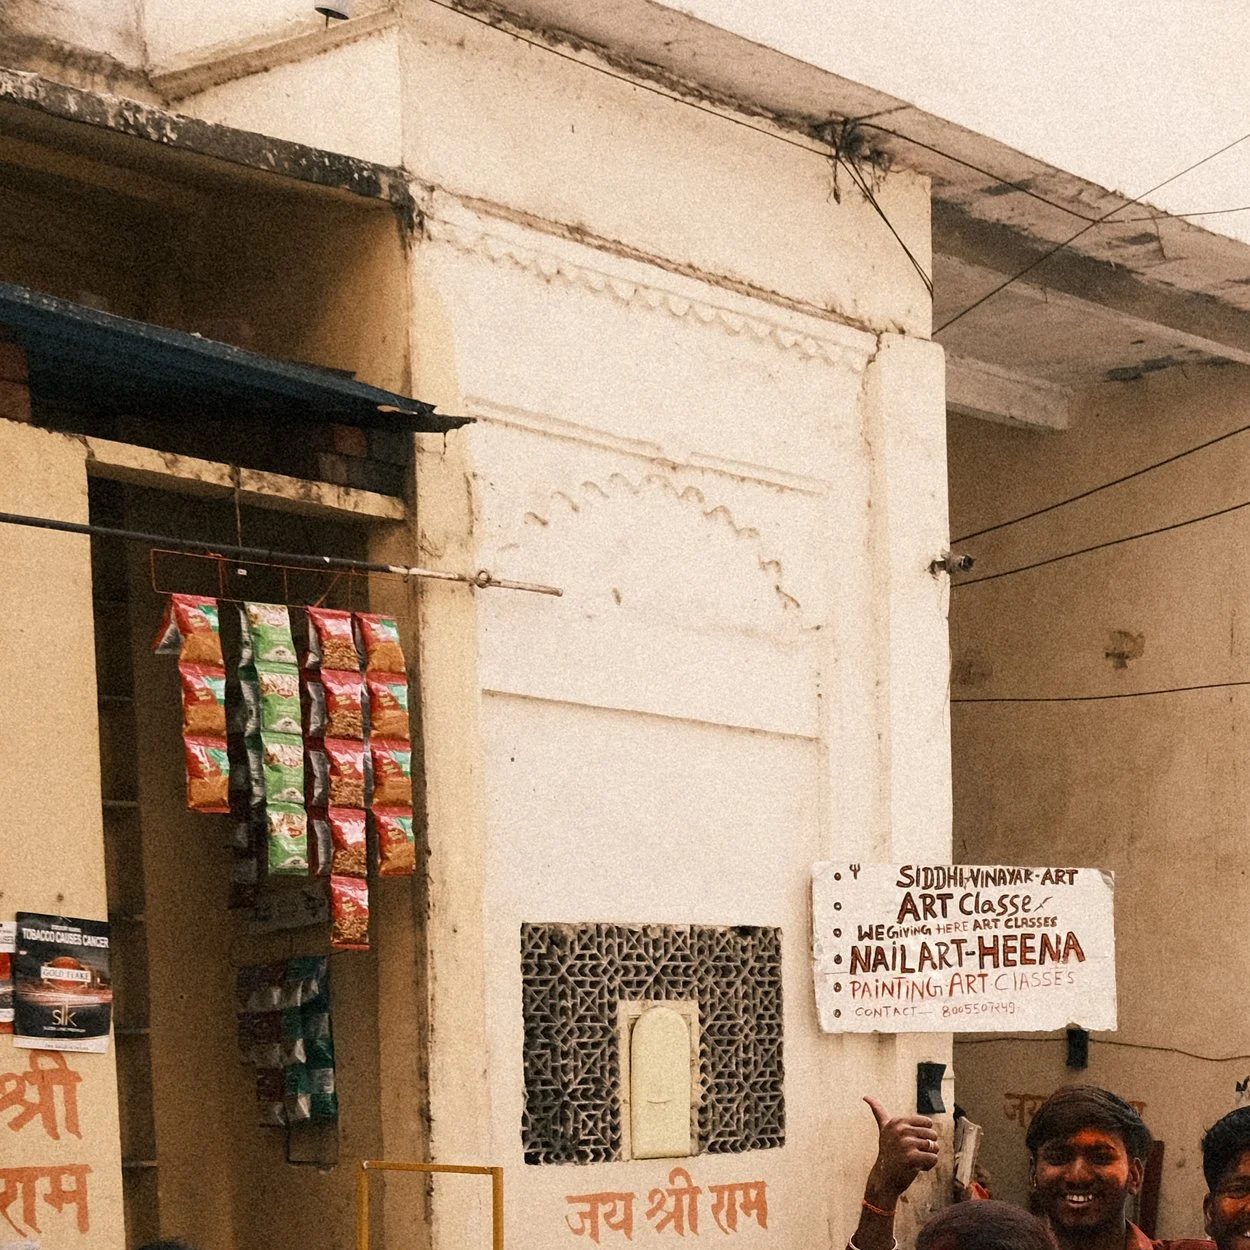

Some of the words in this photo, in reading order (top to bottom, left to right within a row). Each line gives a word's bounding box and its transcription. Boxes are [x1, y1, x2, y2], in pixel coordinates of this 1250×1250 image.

[896, 891, 954, 924] ART
[22, 927, 54, 943] TOBACCO
[56, 931, 82, 946] CAUSES
[83, 934, 109, 949] CANCER
[857, 924, 885, 941] WE
[935, 920, 969, 935] HERE
[973, 918, 1001, 932] ART
[1004, 915, 1058, 930] CLASSES
[42, 968, 64, 978] GOLD
[67, 970, 89, 980] FLAKE
[949, 972, 988, 997] ART
[565, 1192, 638, 1244] जय
[645, 1166, 703, 1237] श्री
[707, 1180, 769, 1235] राम
